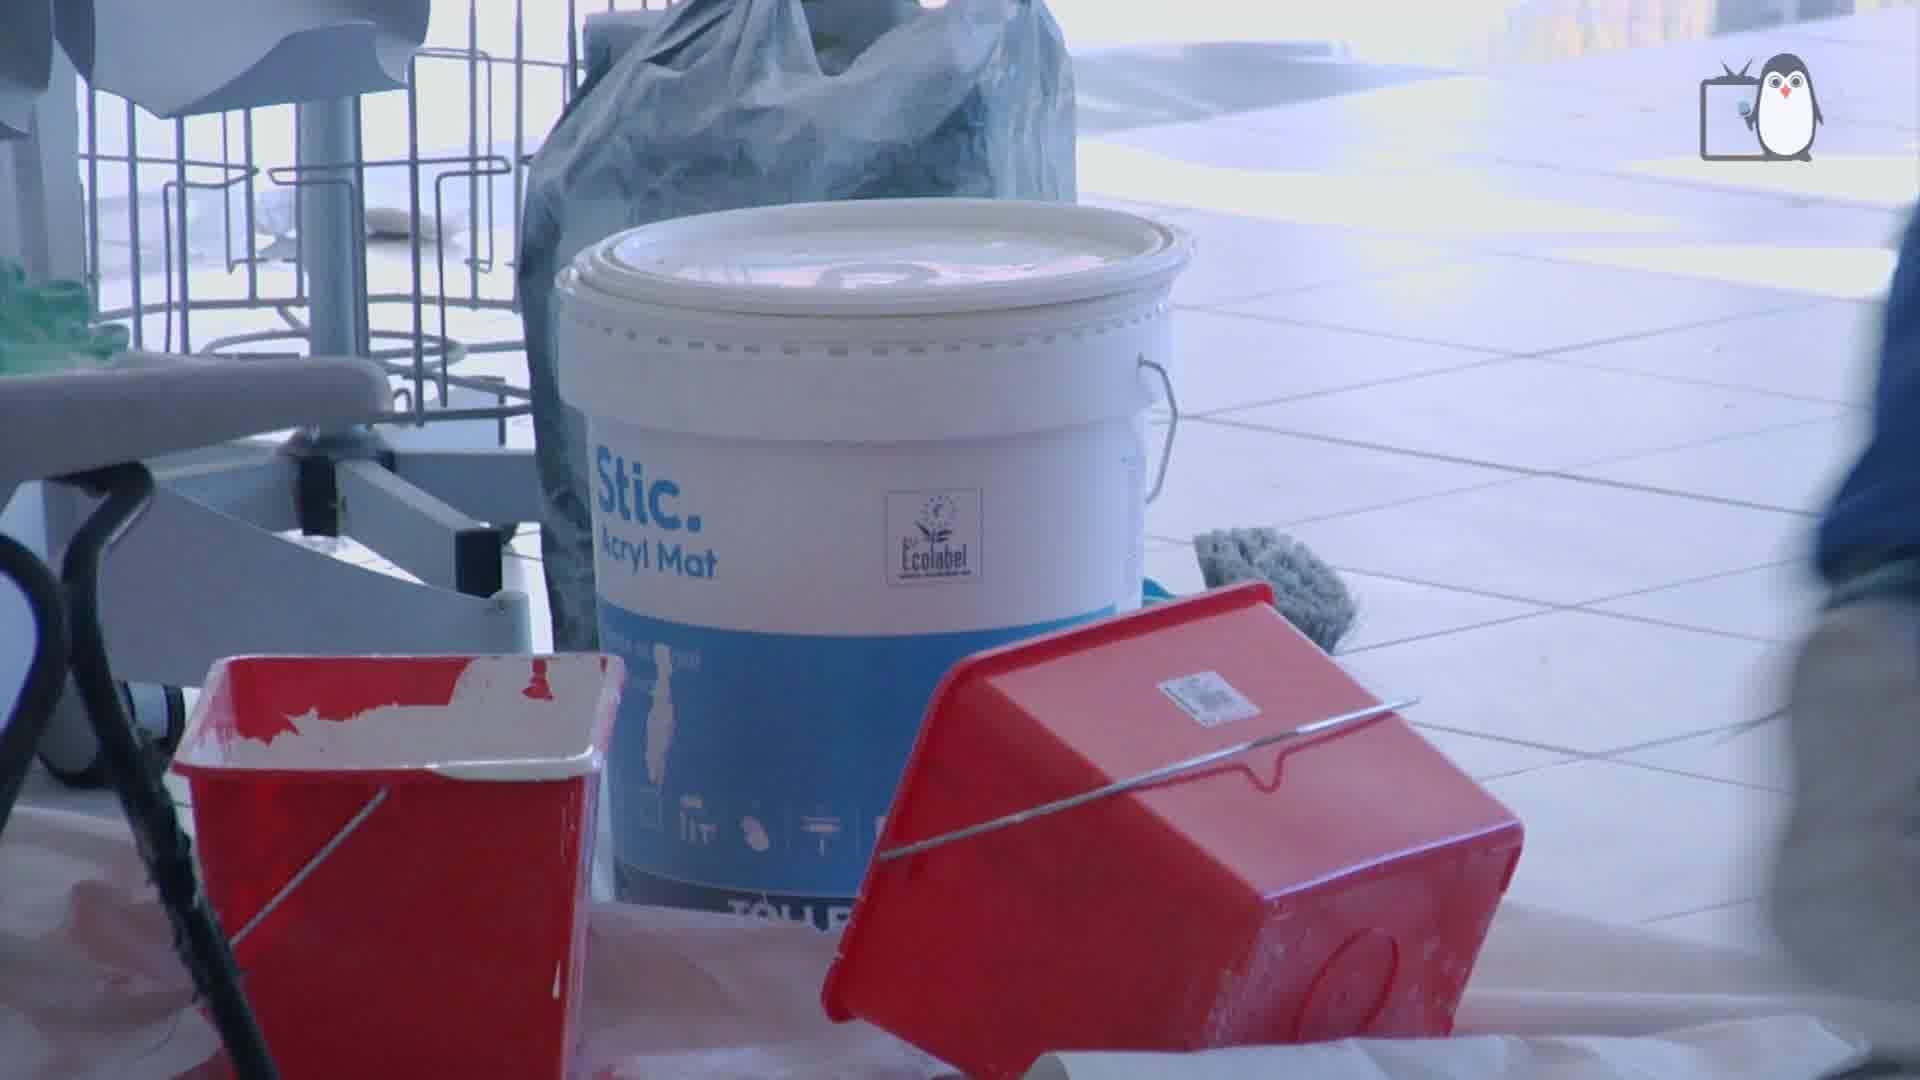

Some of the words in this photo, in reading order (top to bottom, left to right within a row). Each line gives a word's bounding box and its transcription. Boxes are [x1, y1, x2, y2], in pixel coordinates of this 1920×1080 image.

[597, 446, 702, 534] Stic.
[656, 541, 718, 580] Mat
[902, 543, 968, 571] Ecolabel
